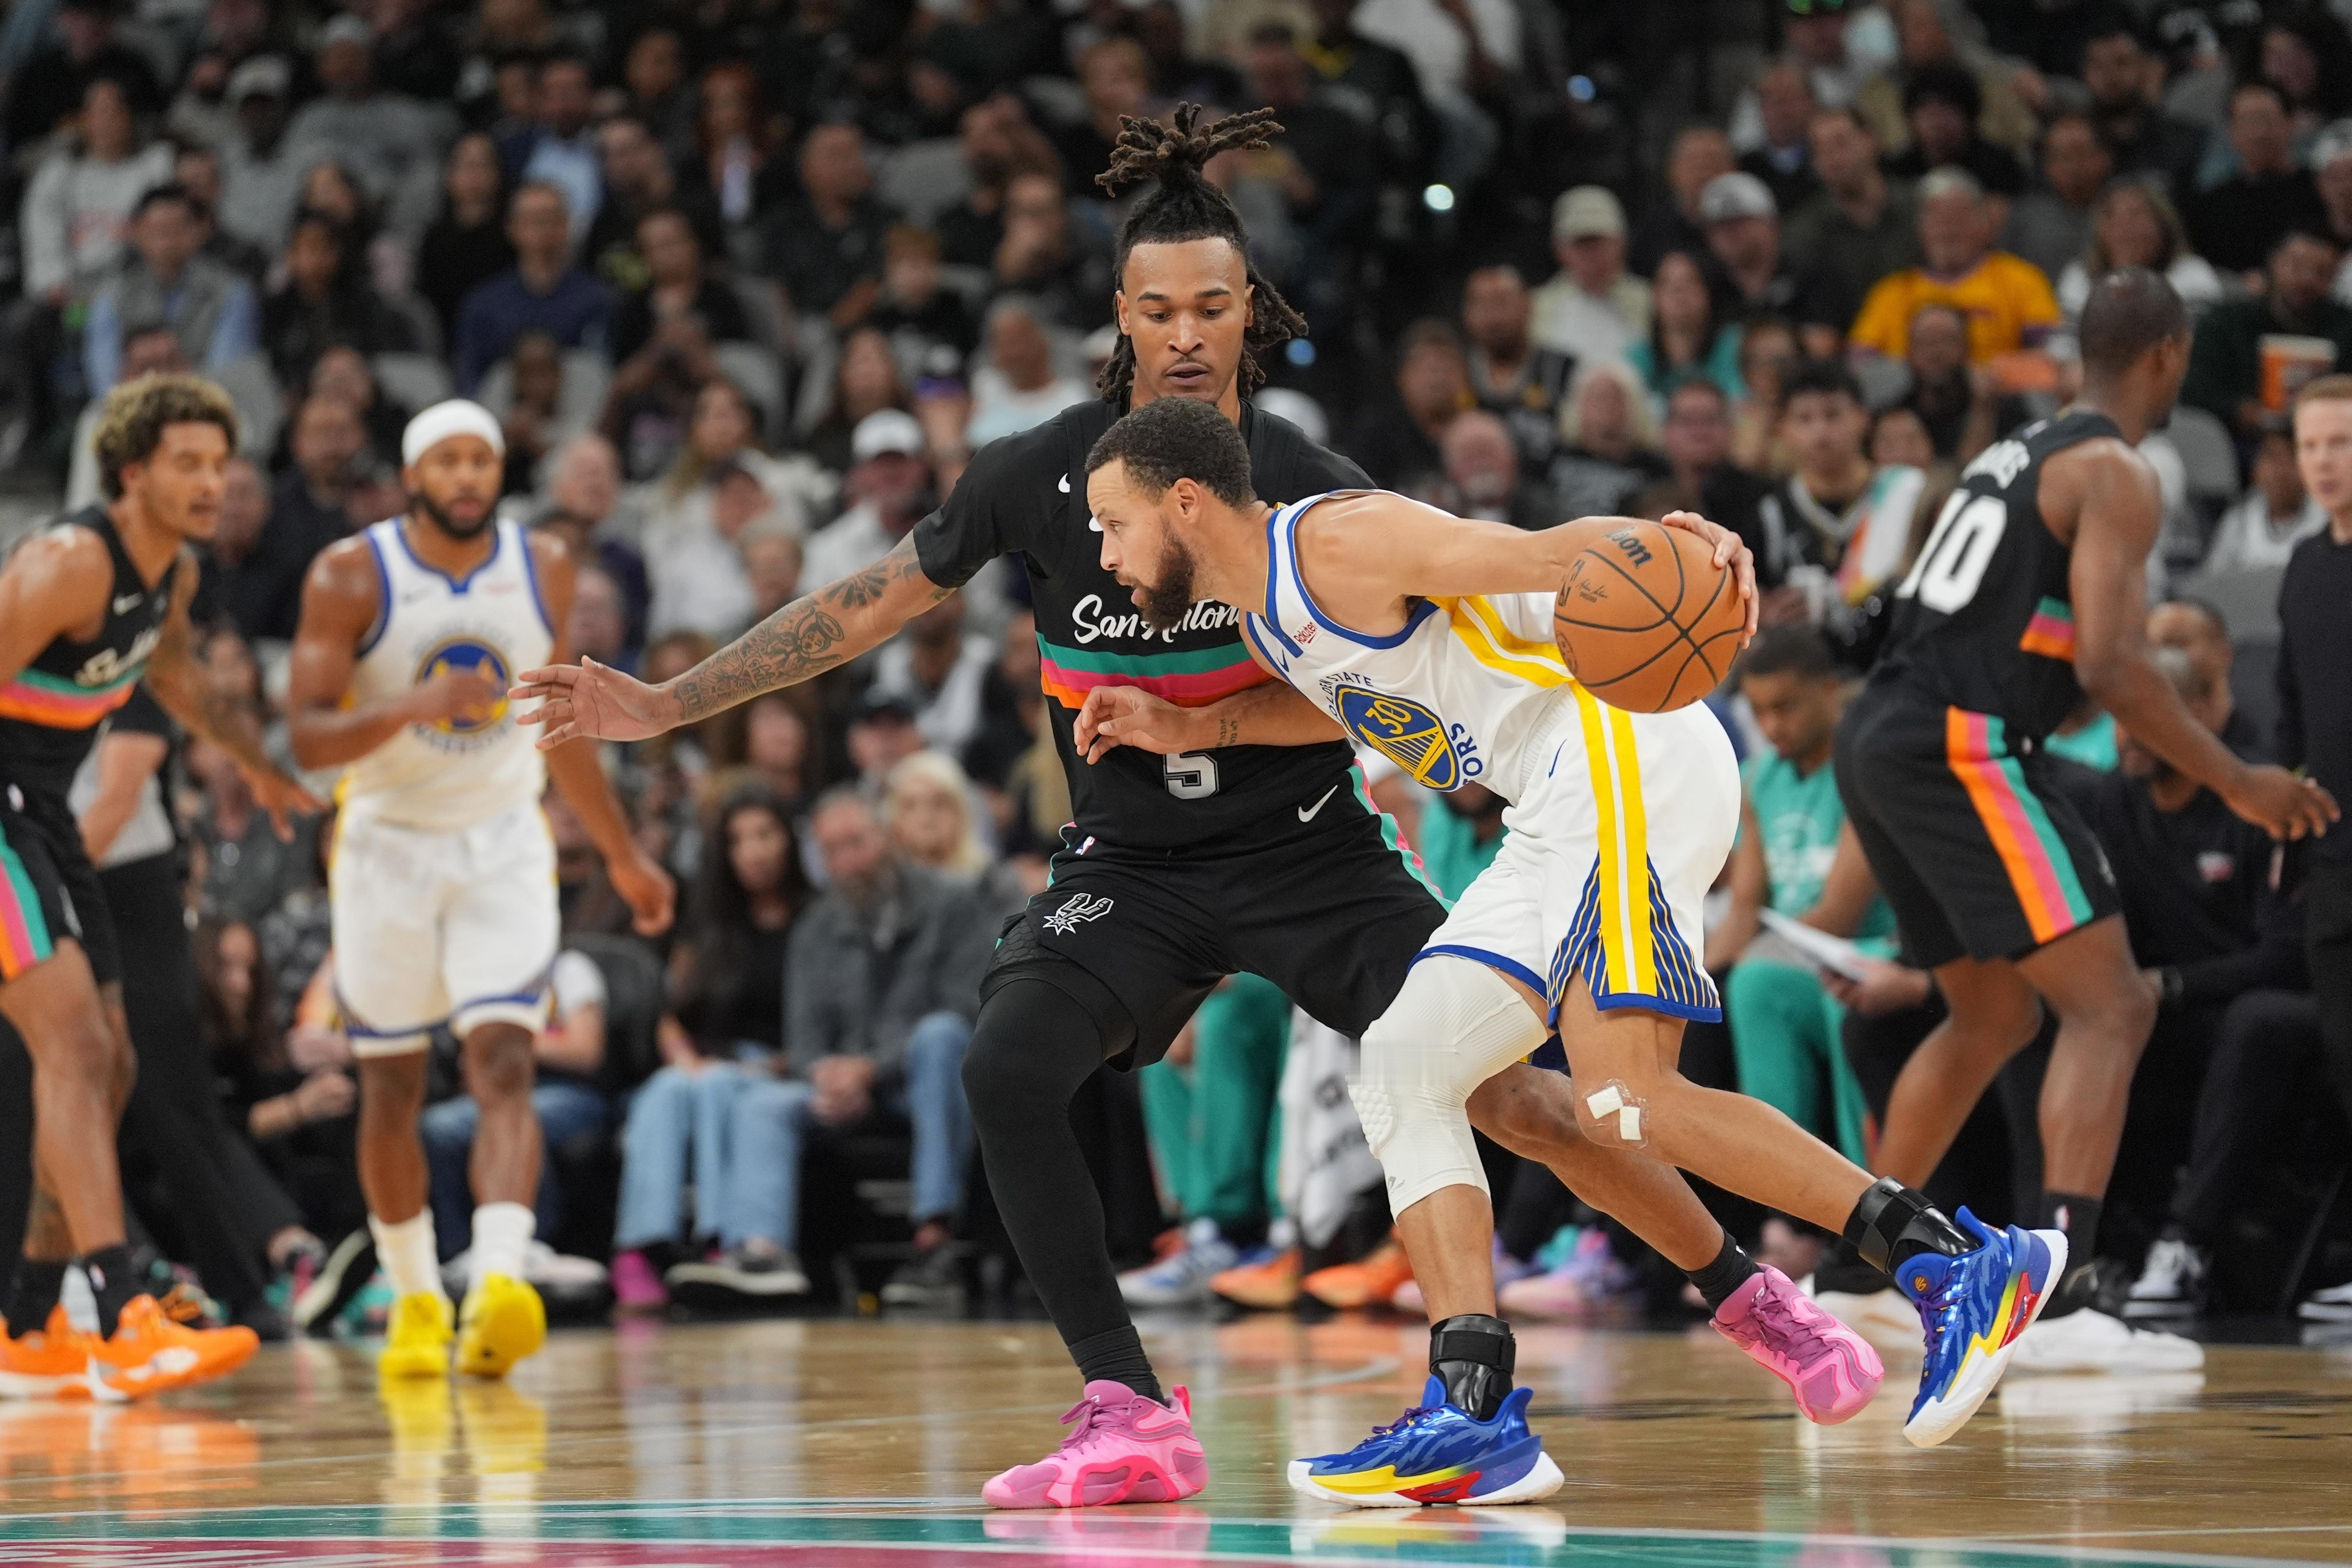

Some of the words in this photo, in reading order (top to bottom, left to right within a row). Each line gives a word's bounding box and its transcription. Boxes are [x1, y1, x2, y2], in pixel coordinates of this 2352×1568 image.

[1072, 594, 1139, 644] San
[1319, 679, 1338, 719] OLDEN
[1326, 672, 1374, 687] STATE
[1365, 700, 1411, 734] 30
[1163, 748, 1220, 800] 5
